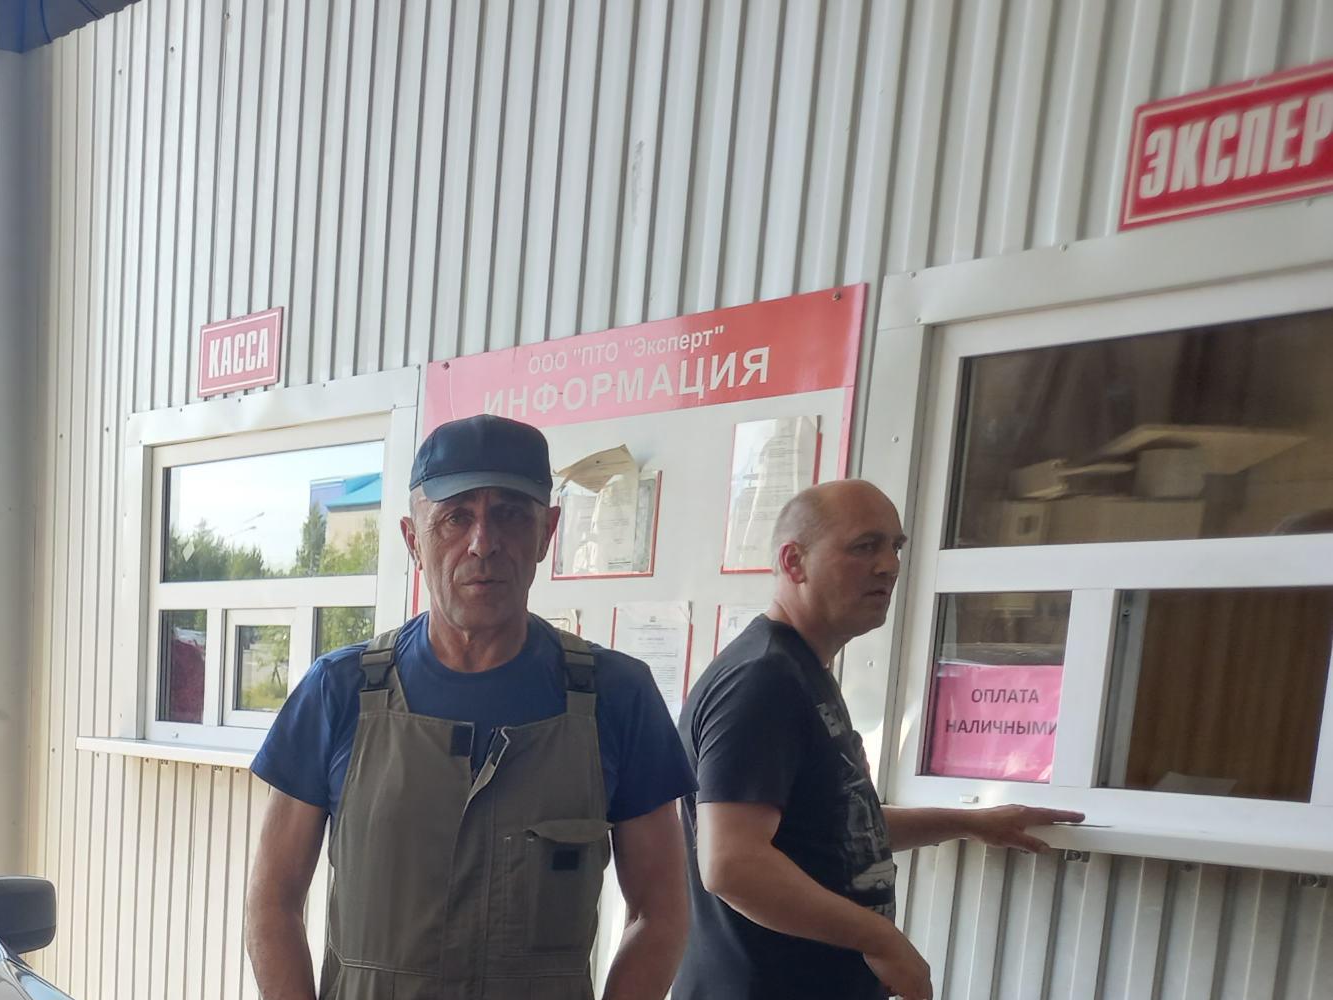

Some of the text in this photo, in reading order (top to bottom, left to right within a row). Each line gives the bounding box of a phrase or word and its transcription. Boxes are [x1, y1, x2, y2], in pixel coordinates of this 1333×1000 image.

[208, 327, 269, 379] КАССА
[528, 325, 725, 375] ООО "ПТО "Эксперт"
[482, 346, 770, 418] ИНФОРМАЦИЯ
[970, 688, 1040, 704] ОПЛАТА
